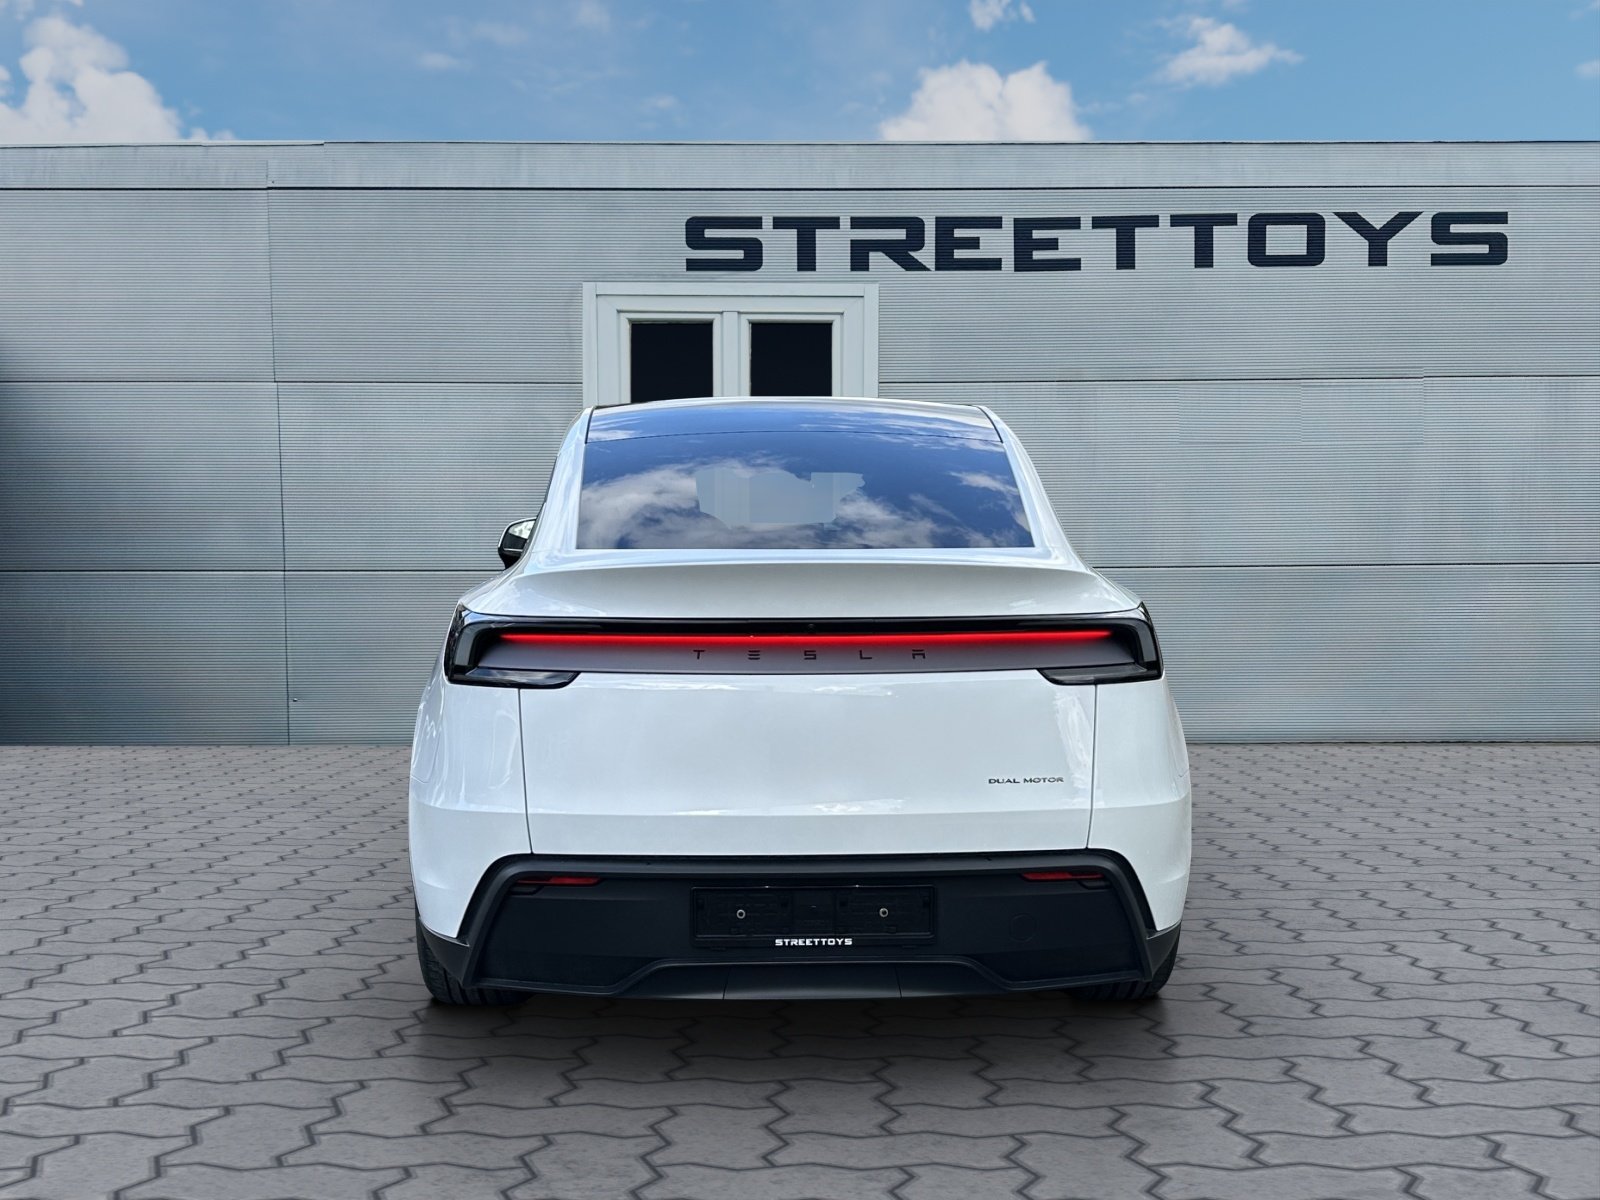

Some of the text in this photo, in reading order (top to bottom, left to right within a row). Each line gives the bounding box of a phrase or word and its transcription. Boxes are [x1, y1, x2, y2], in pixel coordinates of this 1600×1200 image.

[686, 211, 1508, 272] STREETTOYS
[693, 649, 926, 661] TESLA
[775, 938, 853, 946] STREETTOYS
